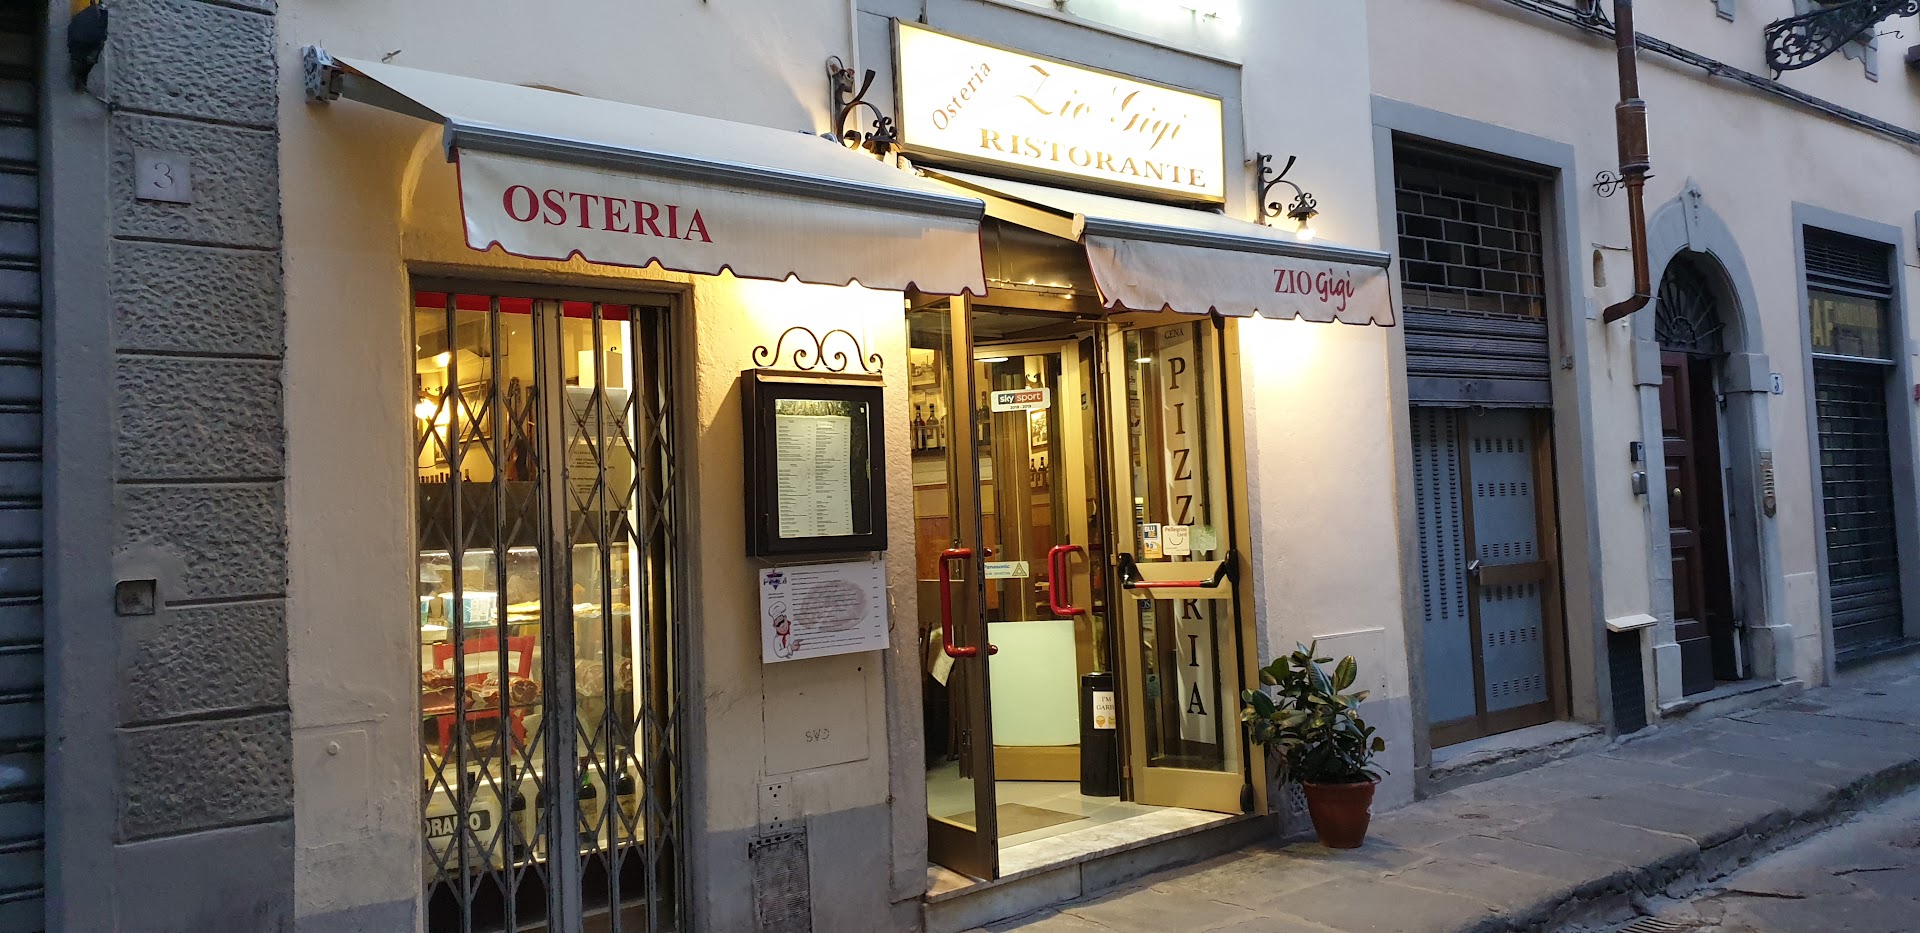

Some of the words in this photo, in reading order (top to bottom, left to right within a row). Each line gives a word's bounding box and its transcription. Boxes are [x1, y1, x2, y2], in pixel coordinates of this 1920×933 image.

[932, 62, 991, 130] Osteria
[1012, 64, 1092, 119] Zio
[1110, 86, 1187, 151] Gigi
[153, 162, 174, 189] 3
[978, 127, 1207, 188] RISTORANTE
[502, 184, 714, 243] OSTERIA
[1273, 268, 1312, 296] ZIO
[1000, 394, 1015, 404] sky
[1016, 392, 1042, 402] sport
[1167, 356, 1207, 716] PIZZRIA
